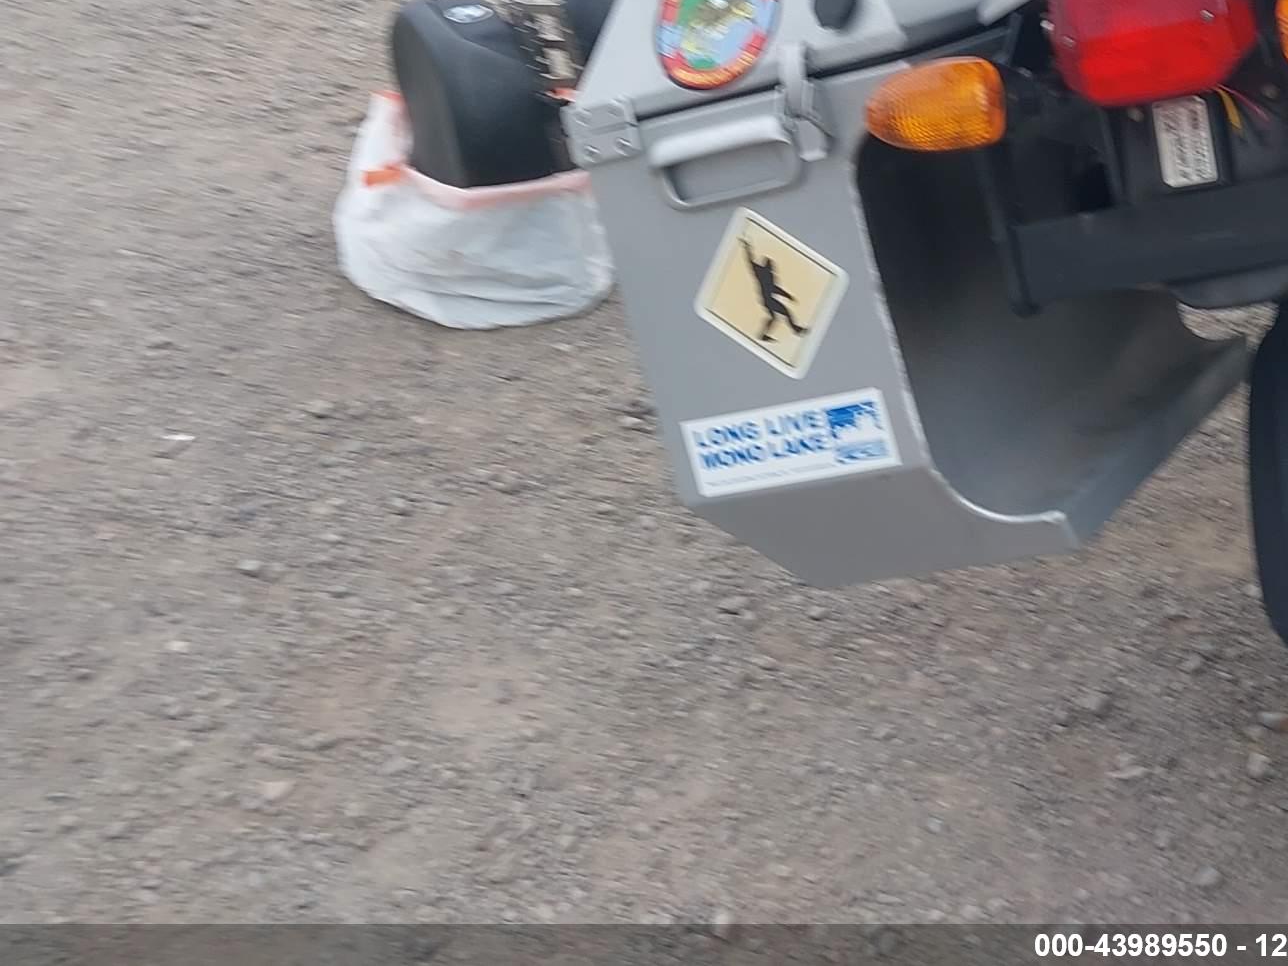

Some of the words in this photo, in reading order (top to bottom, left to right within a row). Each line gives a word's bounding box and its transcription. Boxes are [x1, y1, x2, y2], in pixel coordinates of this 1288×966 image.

[693, 421, 759, 447] LONG
[764, 410, 823, 435] LIVE
[768, 433, 831, 458] LAKE
